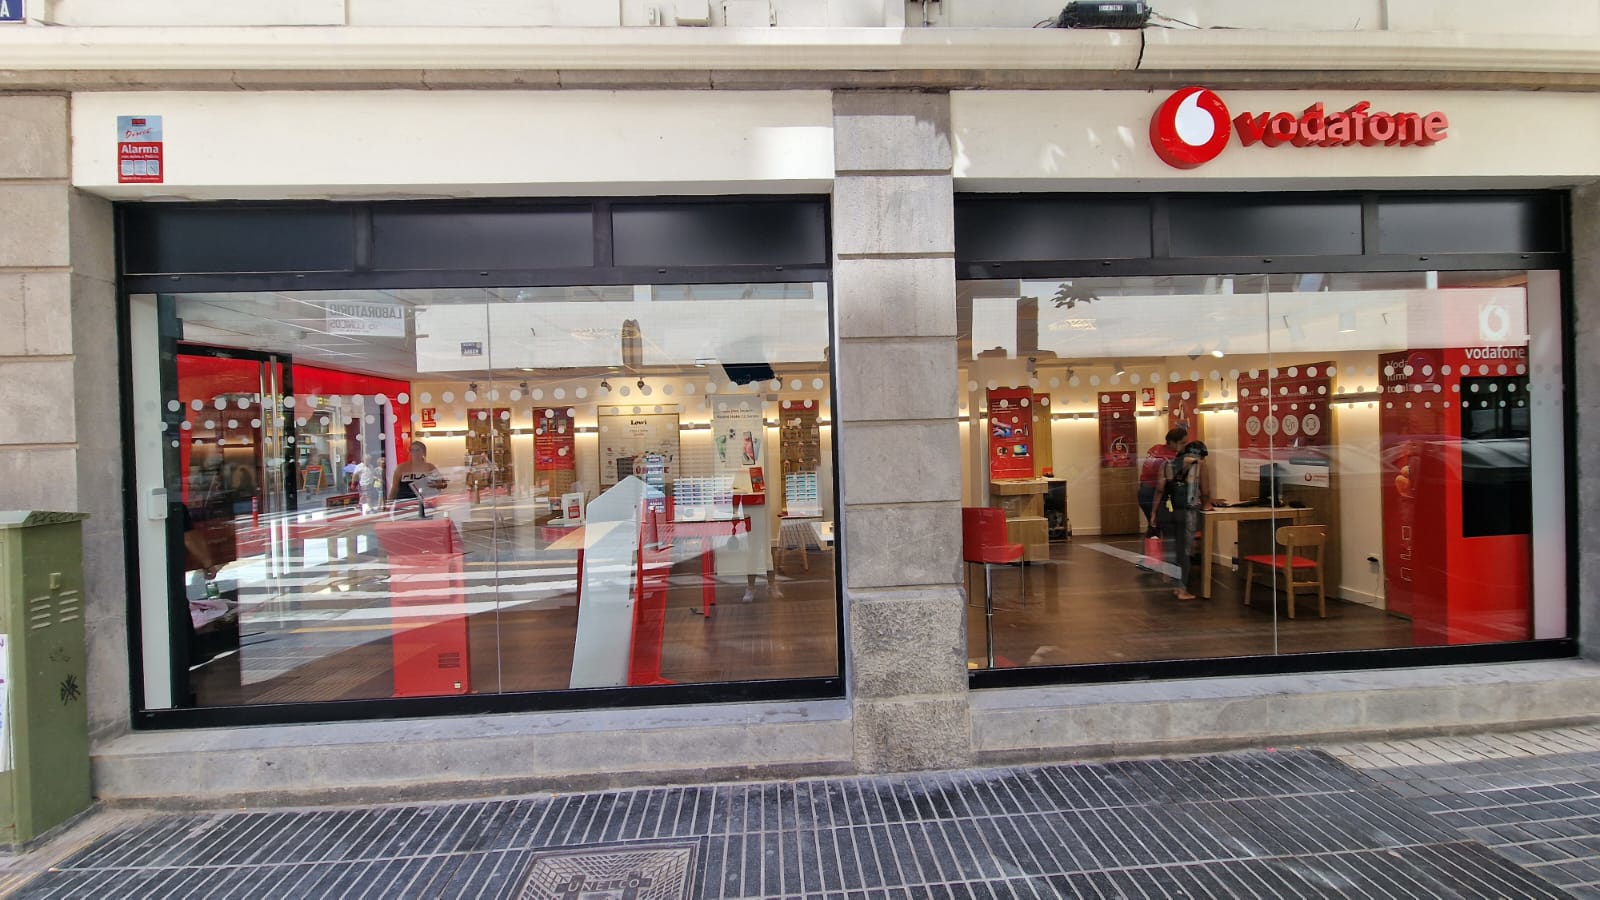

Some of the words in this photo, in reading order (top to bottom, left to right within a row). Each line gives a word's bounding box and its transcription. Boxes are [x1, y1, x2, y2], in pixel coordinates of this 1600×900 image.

[1232, 100, 1448, 148] vodafone
[121, 144, 159, 154] Alarma
[1464, 345, 1526, 359] vodafone
[567, 878, 640, 892] UNELCO
